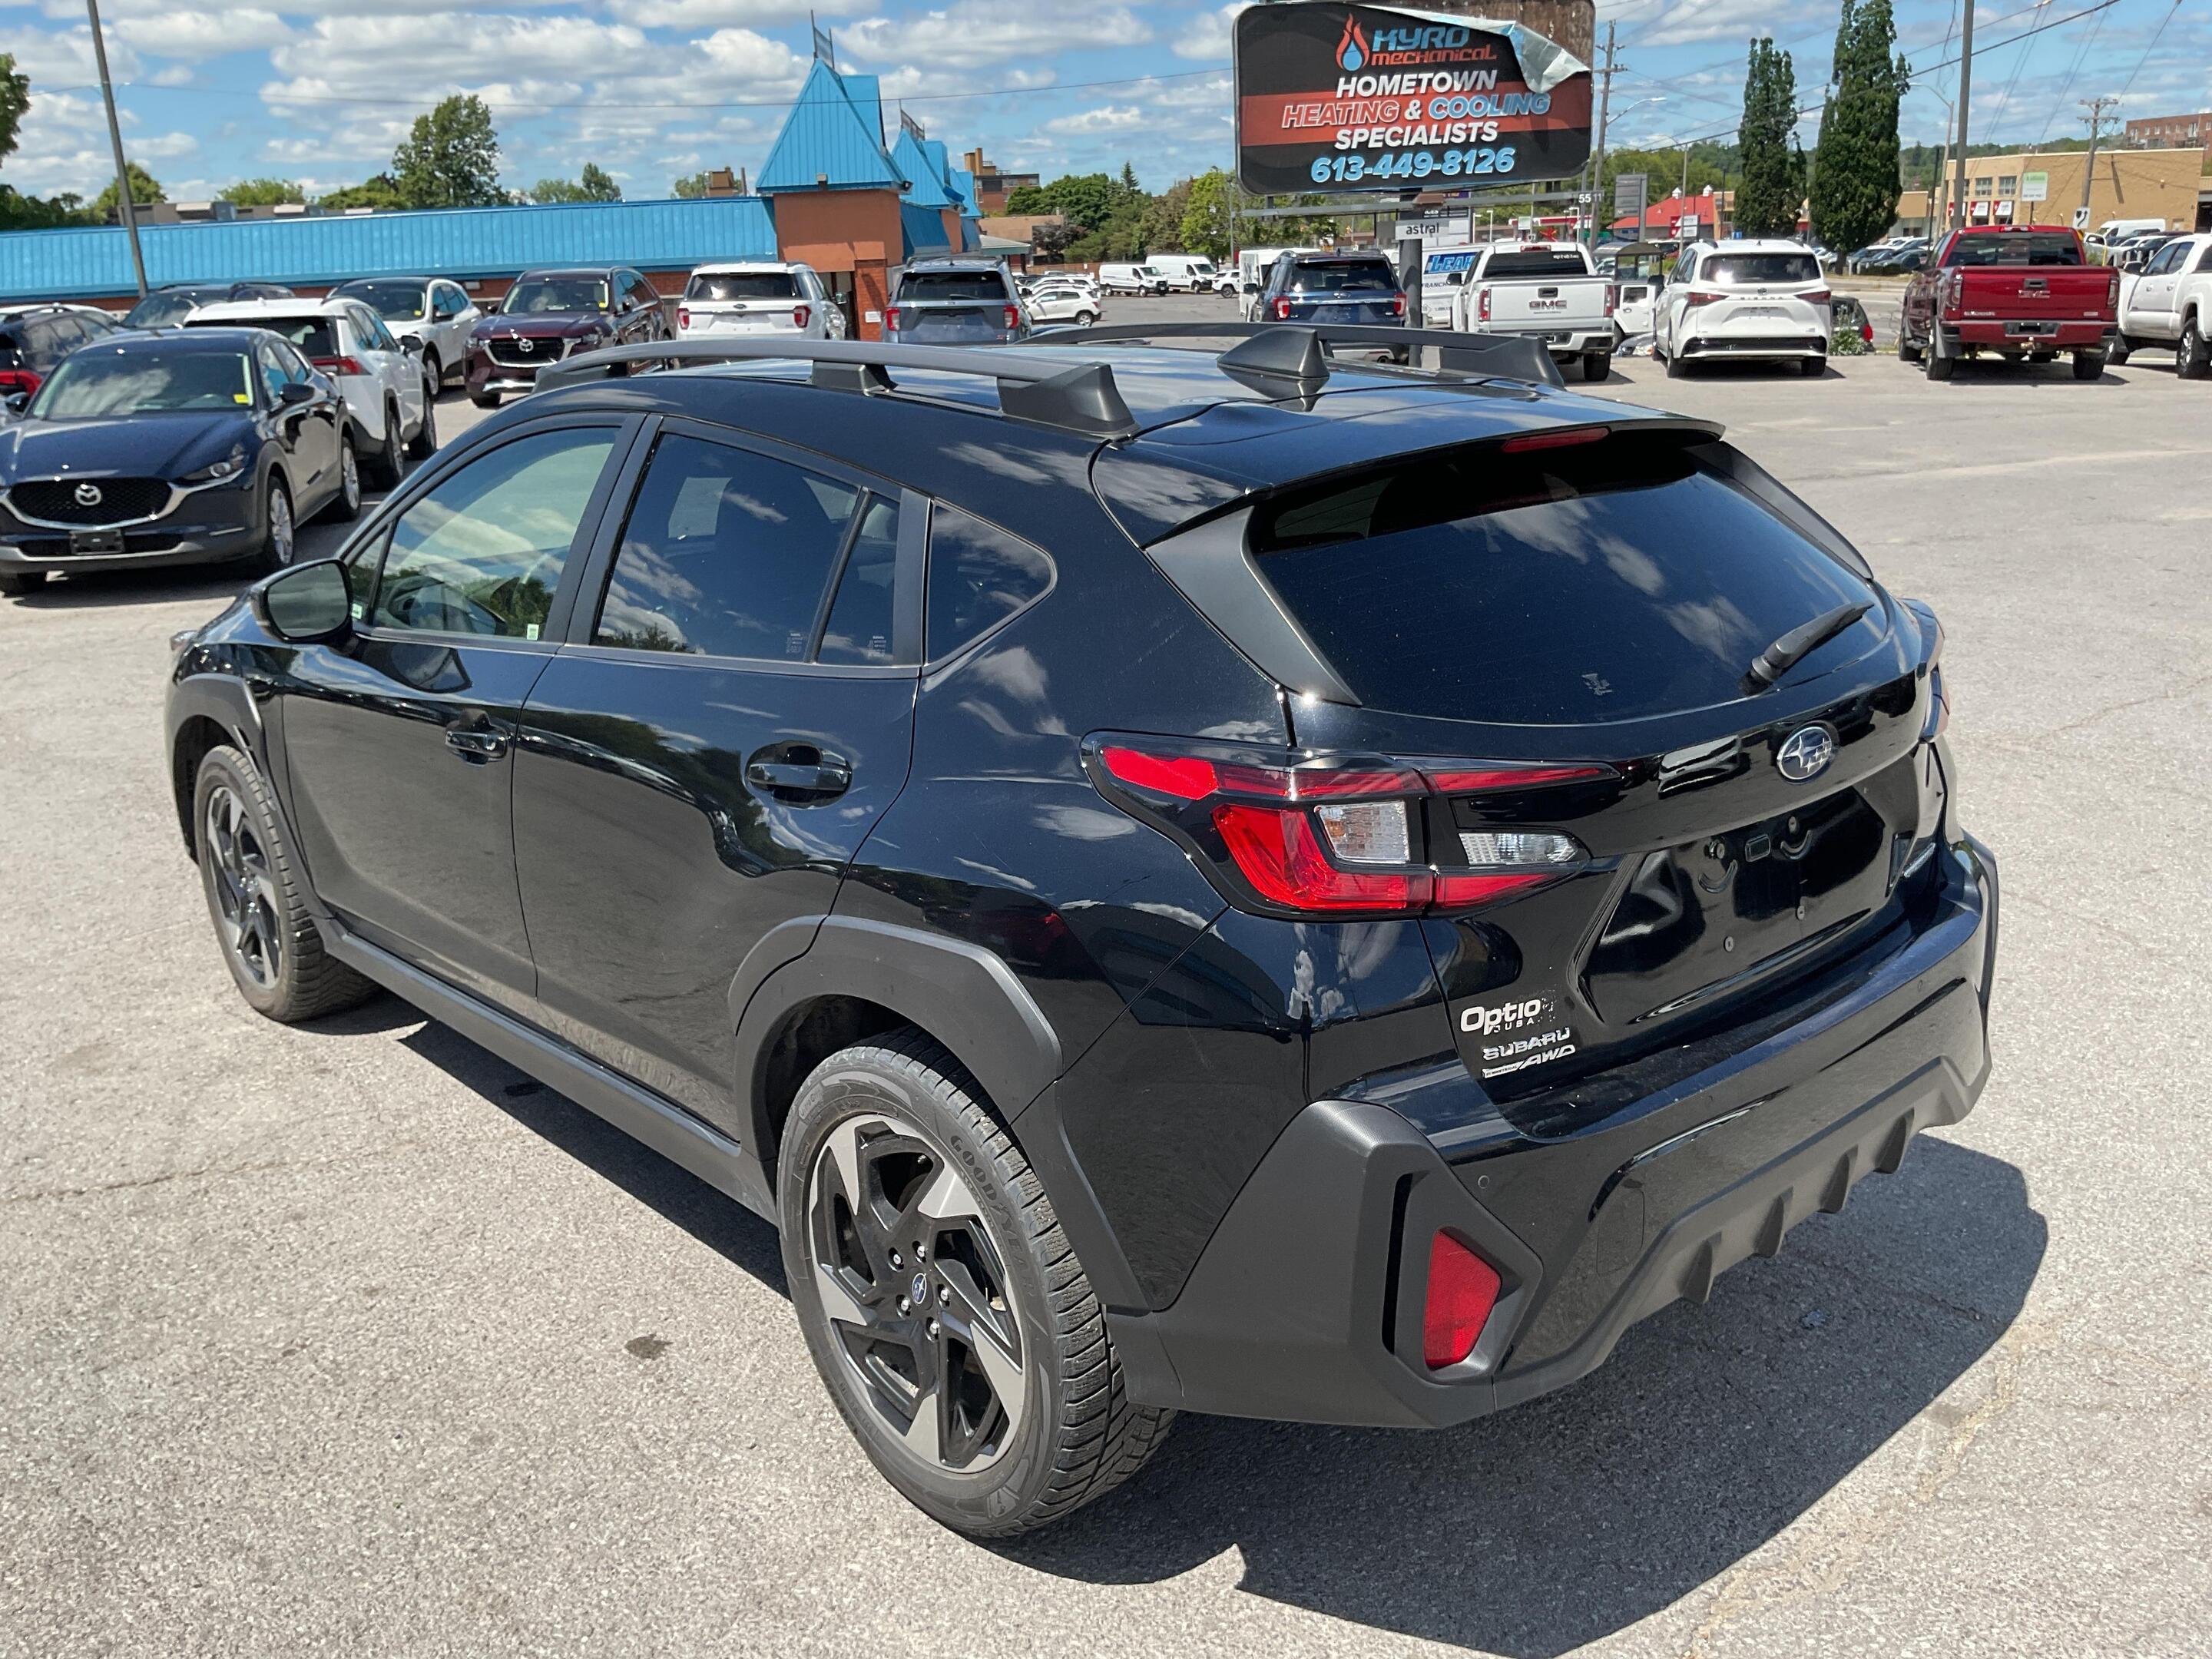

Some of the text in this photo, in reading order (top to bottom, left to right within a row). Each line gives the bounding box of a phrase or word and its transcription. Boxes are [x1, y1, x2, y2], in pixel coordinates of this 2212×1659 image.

[1336, 70, 1498, 98] HOMETOWN
[1281, 93, 1551, 129] HEATING & COOLING
[1334, 121, 1498, 151] SPECIALISTS
[1310, 147, 1516, 184] 613-449-8126
[1406, 222, 1440, 235] astral
[1529, 300, 1567, 310] GMC
[1461, 998, 1554, 1036] Optio
[1482, 1027, 1571, 1061] SUBARU
[1518, 1044, 1576, 1070] AWD
